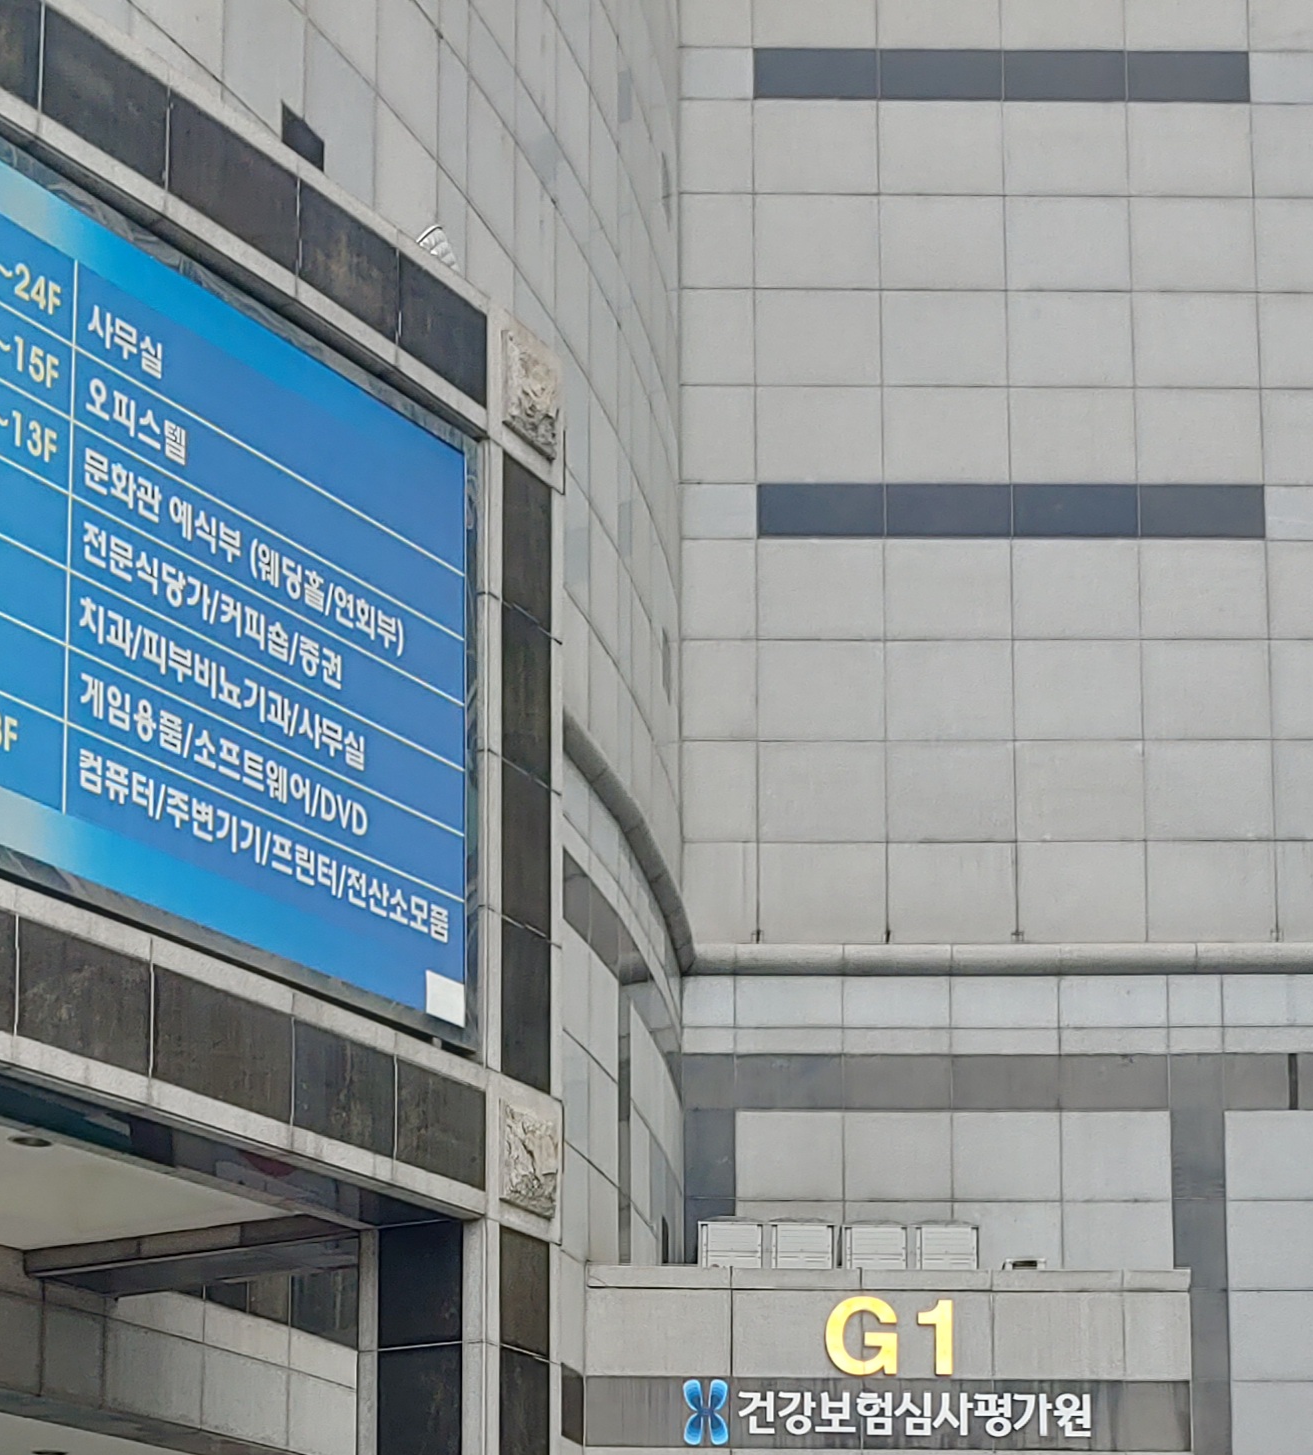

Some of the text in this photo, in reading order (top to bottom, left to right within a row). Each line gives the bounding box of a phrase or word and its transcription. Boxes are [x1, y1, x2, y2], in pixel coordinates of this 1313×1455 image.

[88, 304, 164, 379] 사무실
[86, 378, 187, 467] 오피스텔
[84, 446, 162, 524] 문화관
[169, 496, 242, 561] 예식부
[825, 1295, 955, 1376] G1
[737, 1391, 1092, 1438] 건강보험심사평가원
